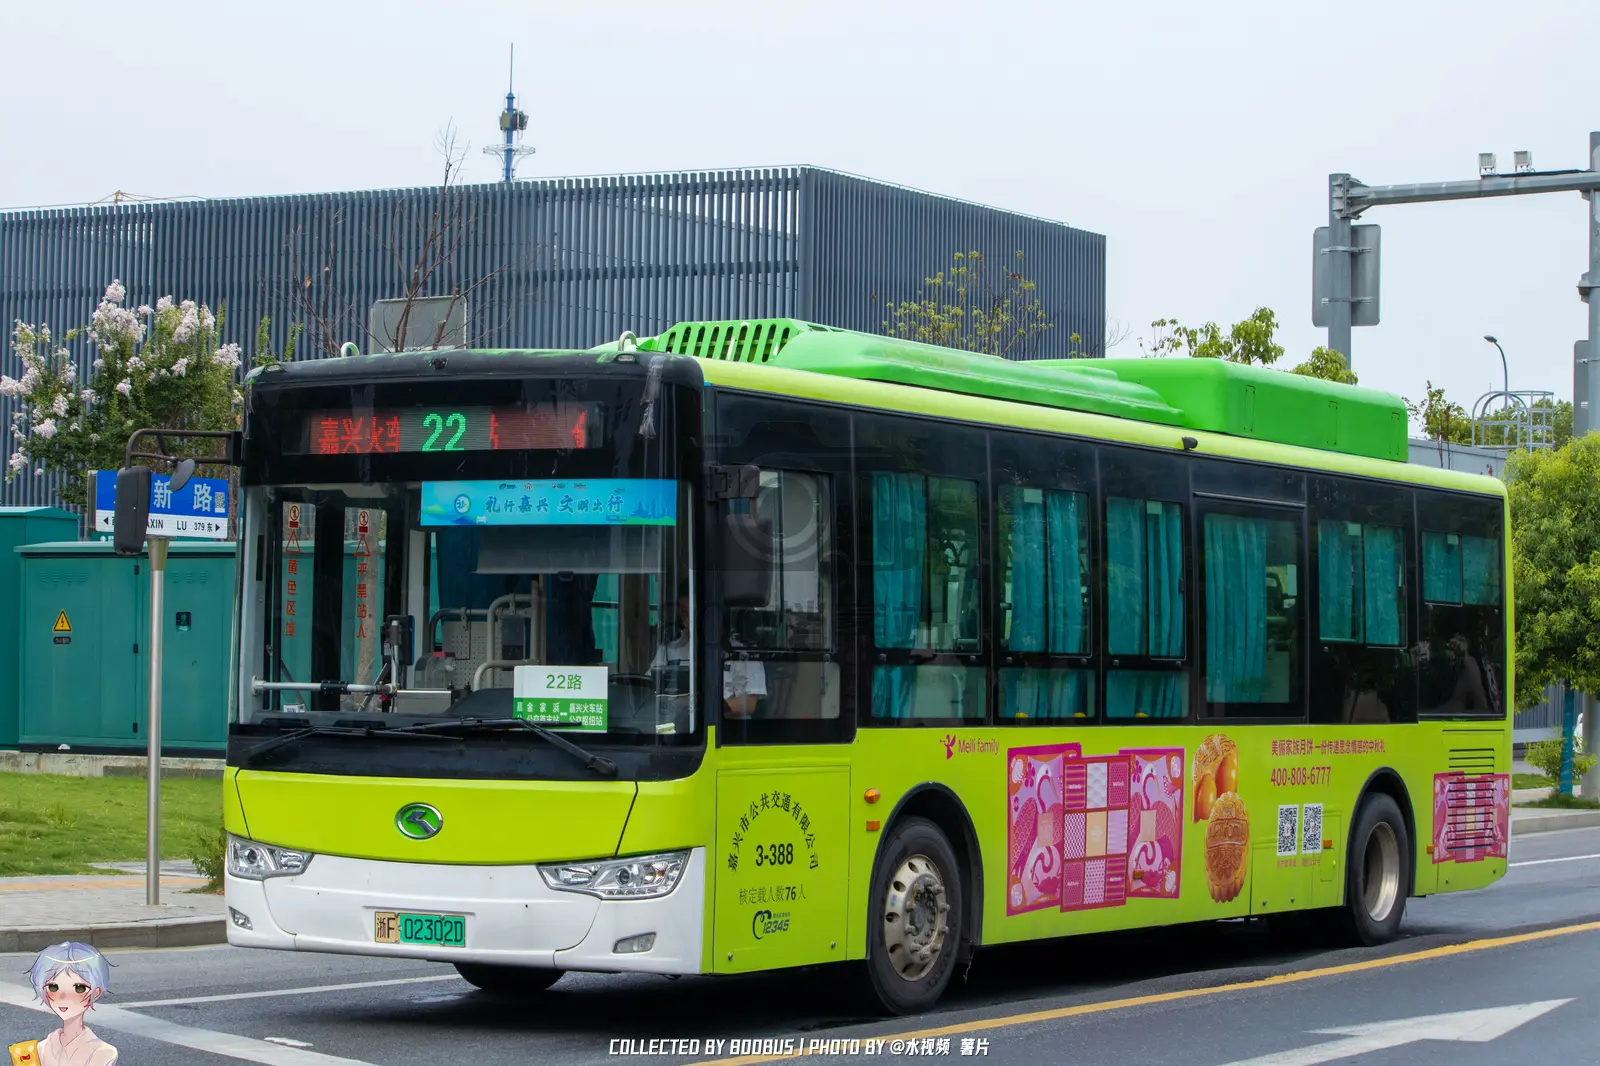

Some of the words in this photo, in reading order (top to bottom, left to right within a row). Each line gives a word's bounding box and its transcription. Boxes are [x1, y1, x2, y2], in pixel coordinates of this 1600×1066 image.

[421, 413, 467, 452] 22
[114, 480, 212, 512] 新路
[485, 494, 549, 513] 礼行嘉兴
[558, 494, 624, 513] 文明出行
[177, 521, 187, 530] LU
[356, 563, 368, 639] 严禁站人
[546, 674, 582, 690] 22路
[569, 702, 603, 714] 嘉兴火车站
[977, 737, 999, 755] family
[1270, 766, 1331, 786] 400-808-6777
[728, 790, 819, 872] 嘉兴市公共交通有限公司
[755, 843, 794, 867] 3-388
[377, 917, 396, 939] 浙F
[404, 918, 464, 943] 02302D
[763, 918, 790, 934] 12345
